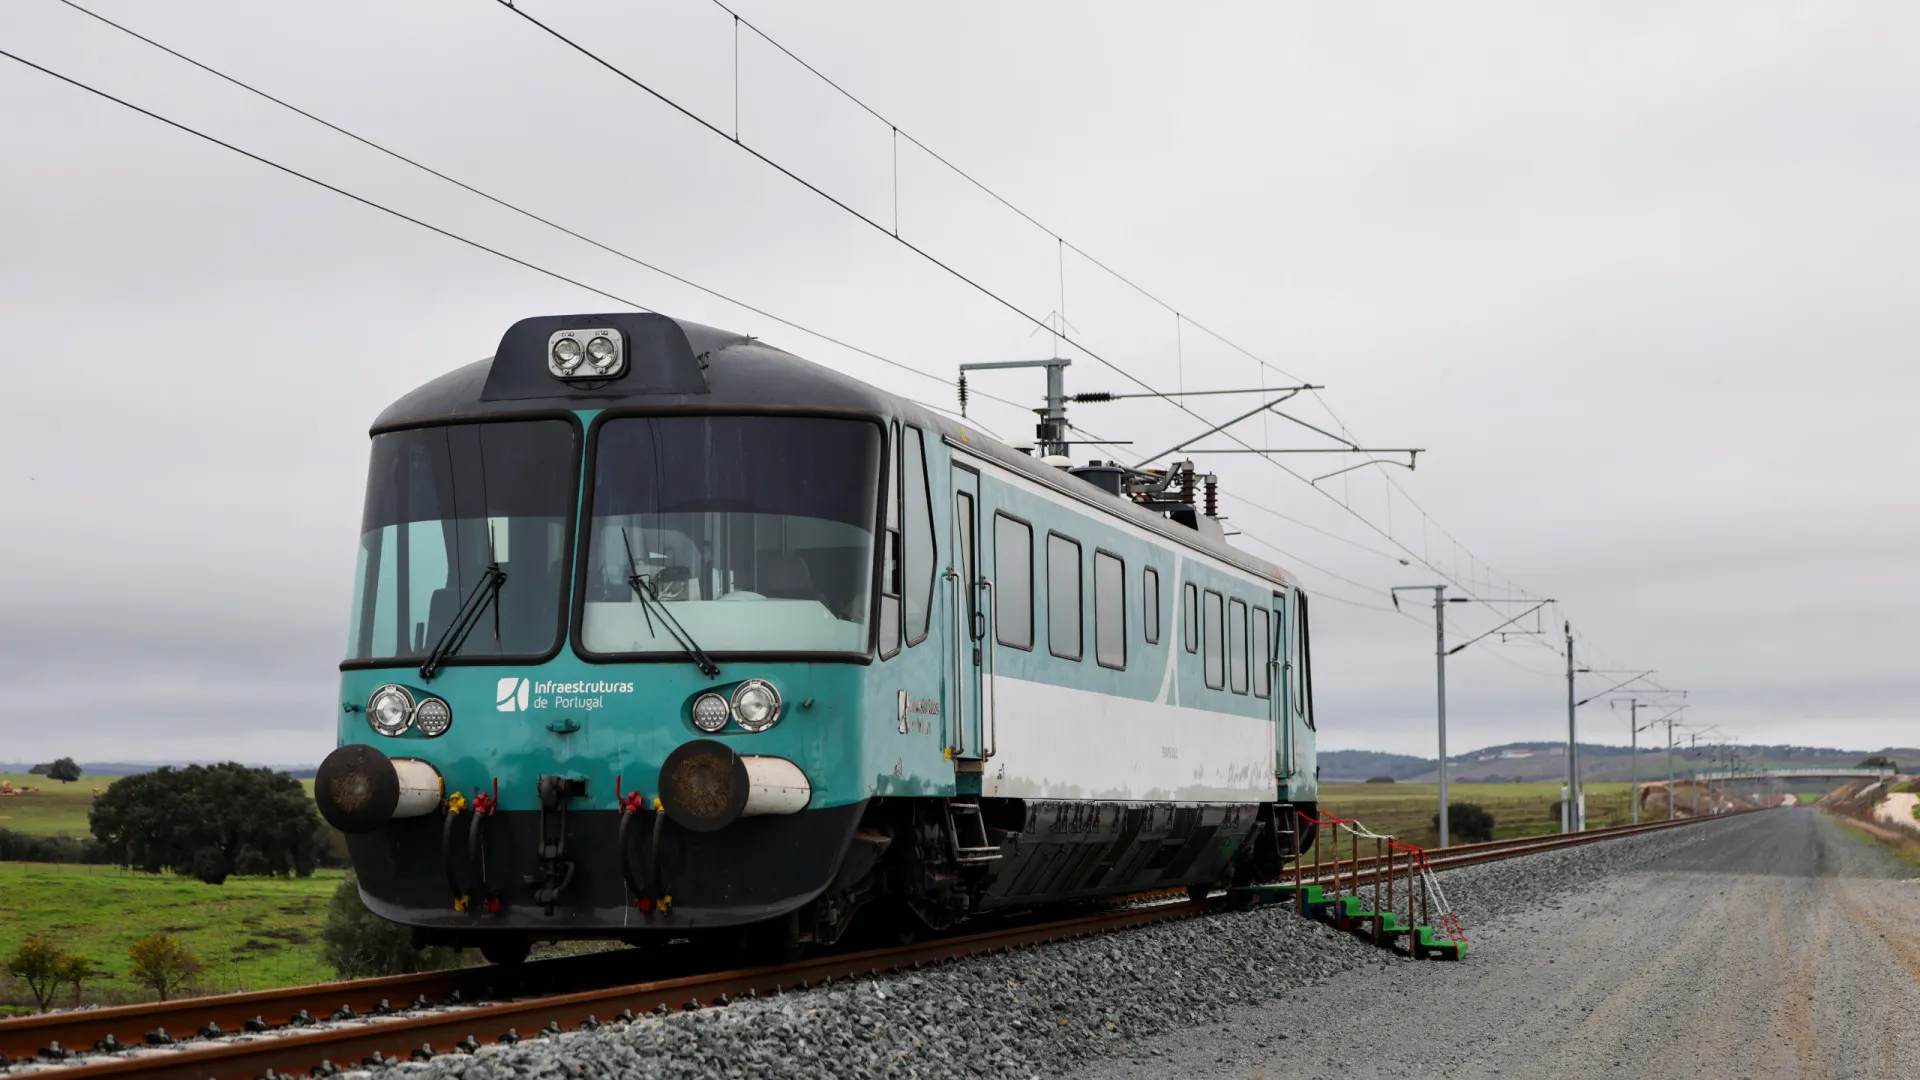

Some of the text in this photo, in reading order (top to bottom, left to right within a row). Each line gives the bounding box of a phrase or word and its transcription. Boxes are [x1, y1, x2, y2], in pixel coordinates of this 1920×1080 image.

[534, 680, 634, 694] Infraestruturas
[534, 696, 603, 711] de Portugal
